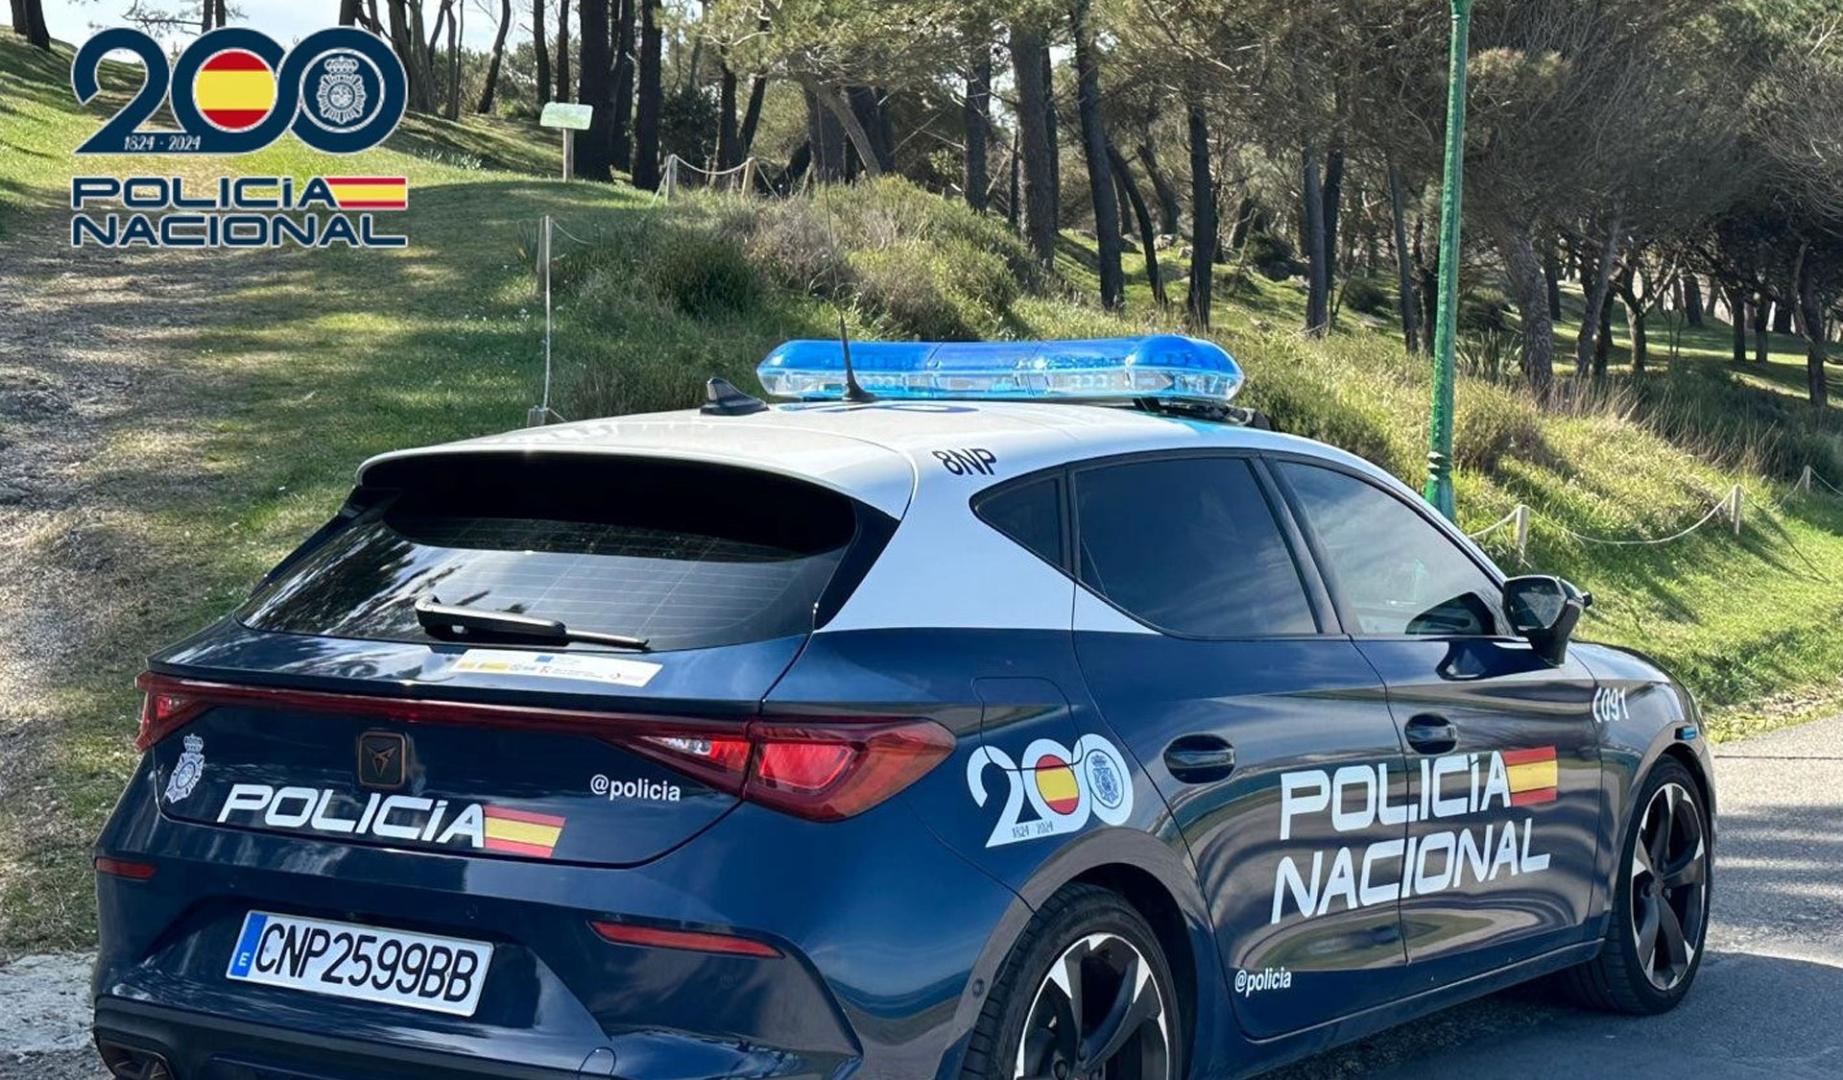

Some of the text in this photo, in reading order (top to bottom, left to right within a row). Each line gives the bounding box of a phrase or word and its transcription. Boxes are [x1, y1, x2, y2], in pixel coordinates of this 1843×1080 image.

[931, 448, 997, 476] 8NP
[1601, 687, 1630, 721] 091
[590, 773, 681, 802] @policia
[1271, 818, 1550, 925] NACIONAL
[238, 952, 249, 967] E
[255, 922, 478, 1003] CNP2599BB
[1234, 966, 1292, 998] @policia
